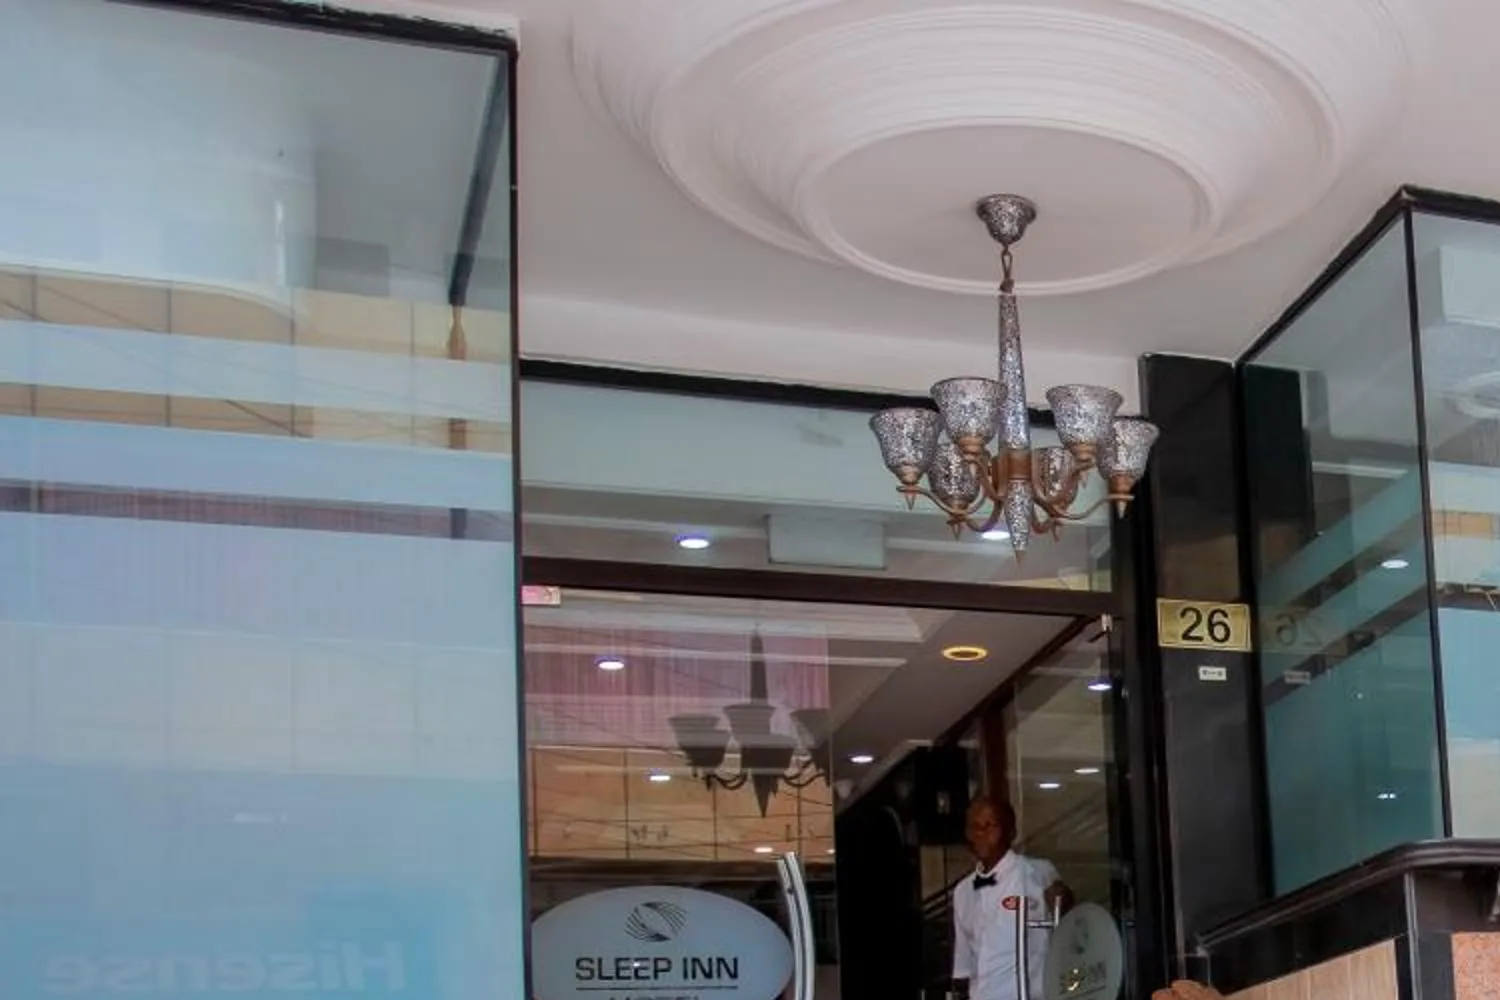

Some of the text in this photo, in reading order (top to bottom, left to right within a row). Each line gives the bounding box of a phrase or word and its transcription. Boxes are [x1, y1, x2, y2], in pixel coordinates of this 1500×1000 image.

[1180, 606, 1231, 643] 26
[575, 956, 739, 981] SLEEP INN
